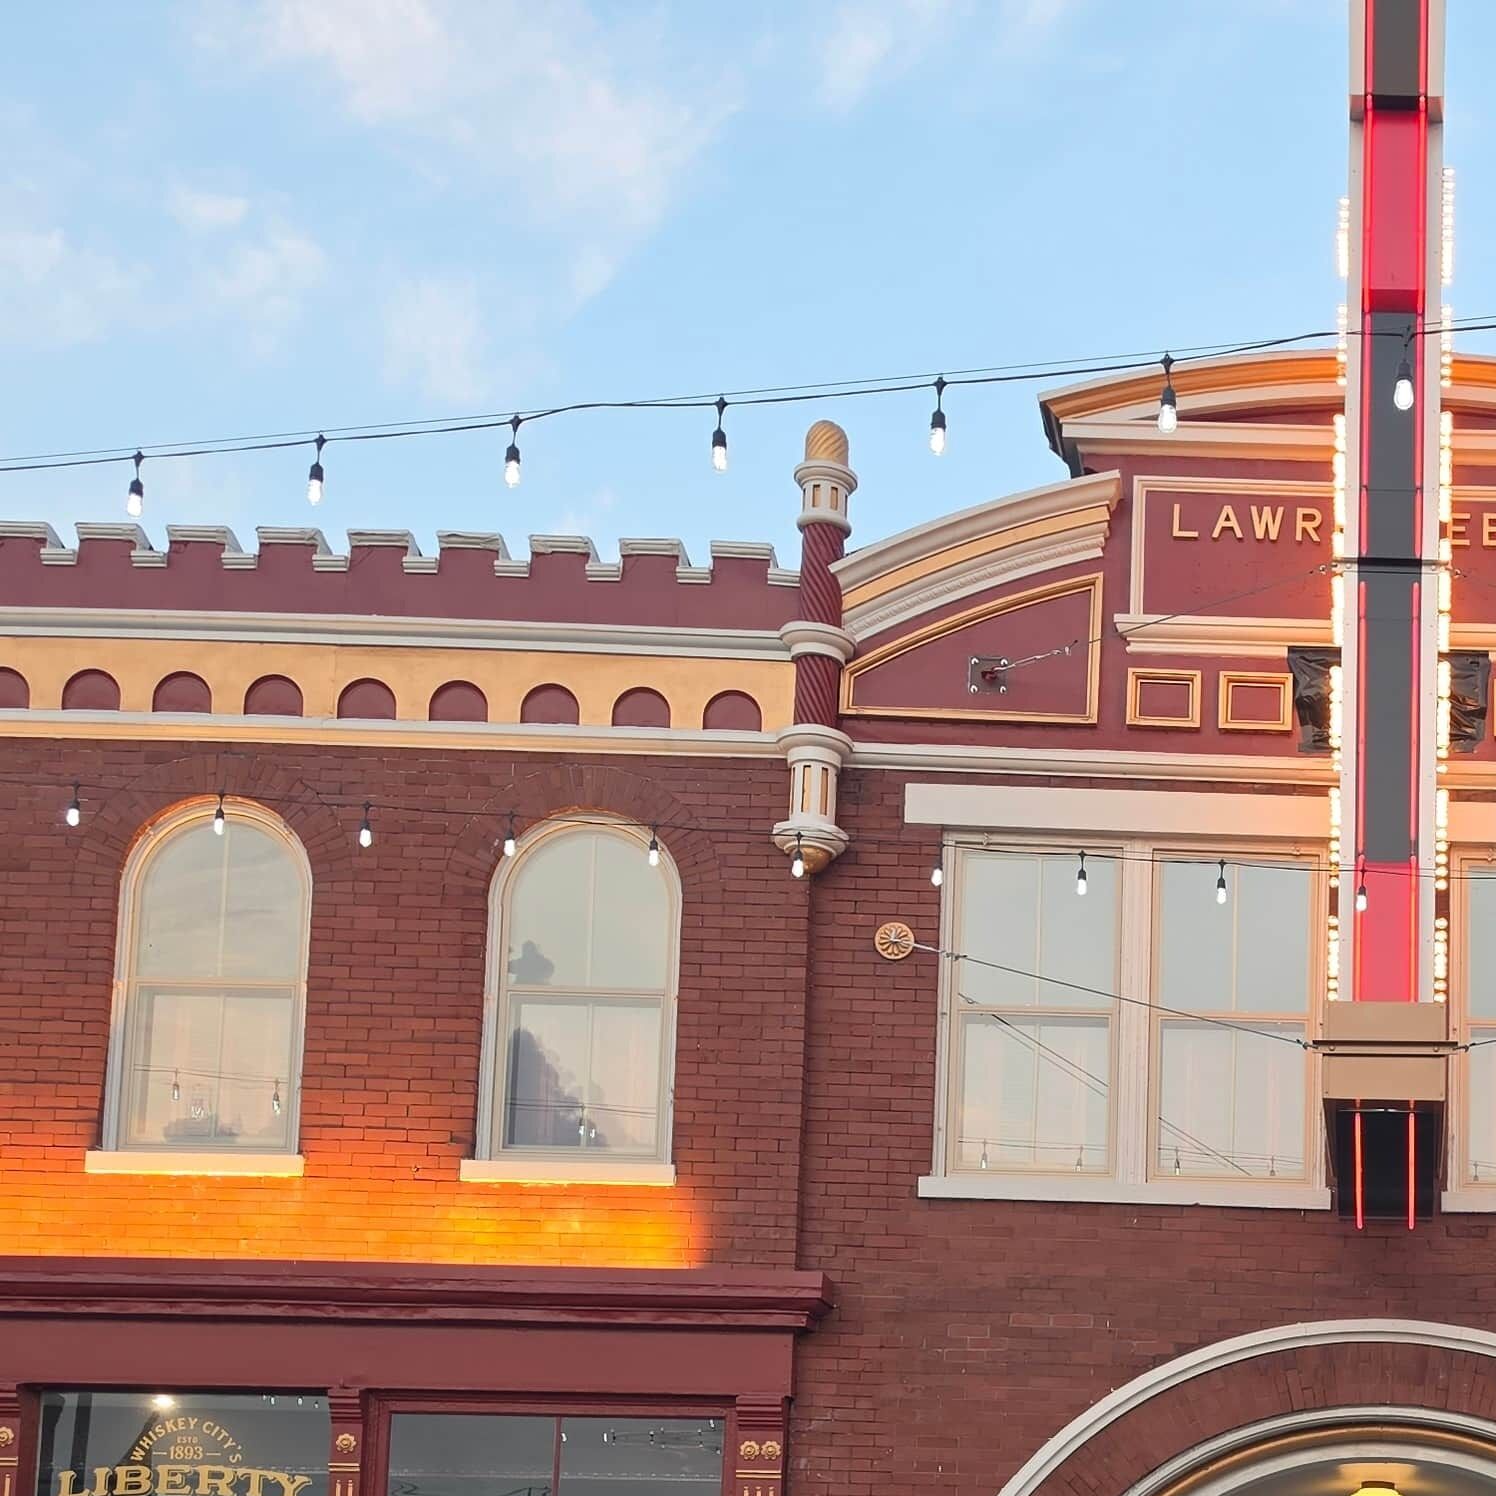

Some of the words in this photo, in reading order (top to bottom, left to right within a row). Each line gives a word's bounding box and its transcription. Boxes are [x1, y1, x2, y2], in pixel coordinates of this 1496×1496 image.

[130, 1416, 198, 1463] WHISKEY
[202, 1420, 243, 1464] CITY'S
[169, 1445, 203, 1460] 1893
